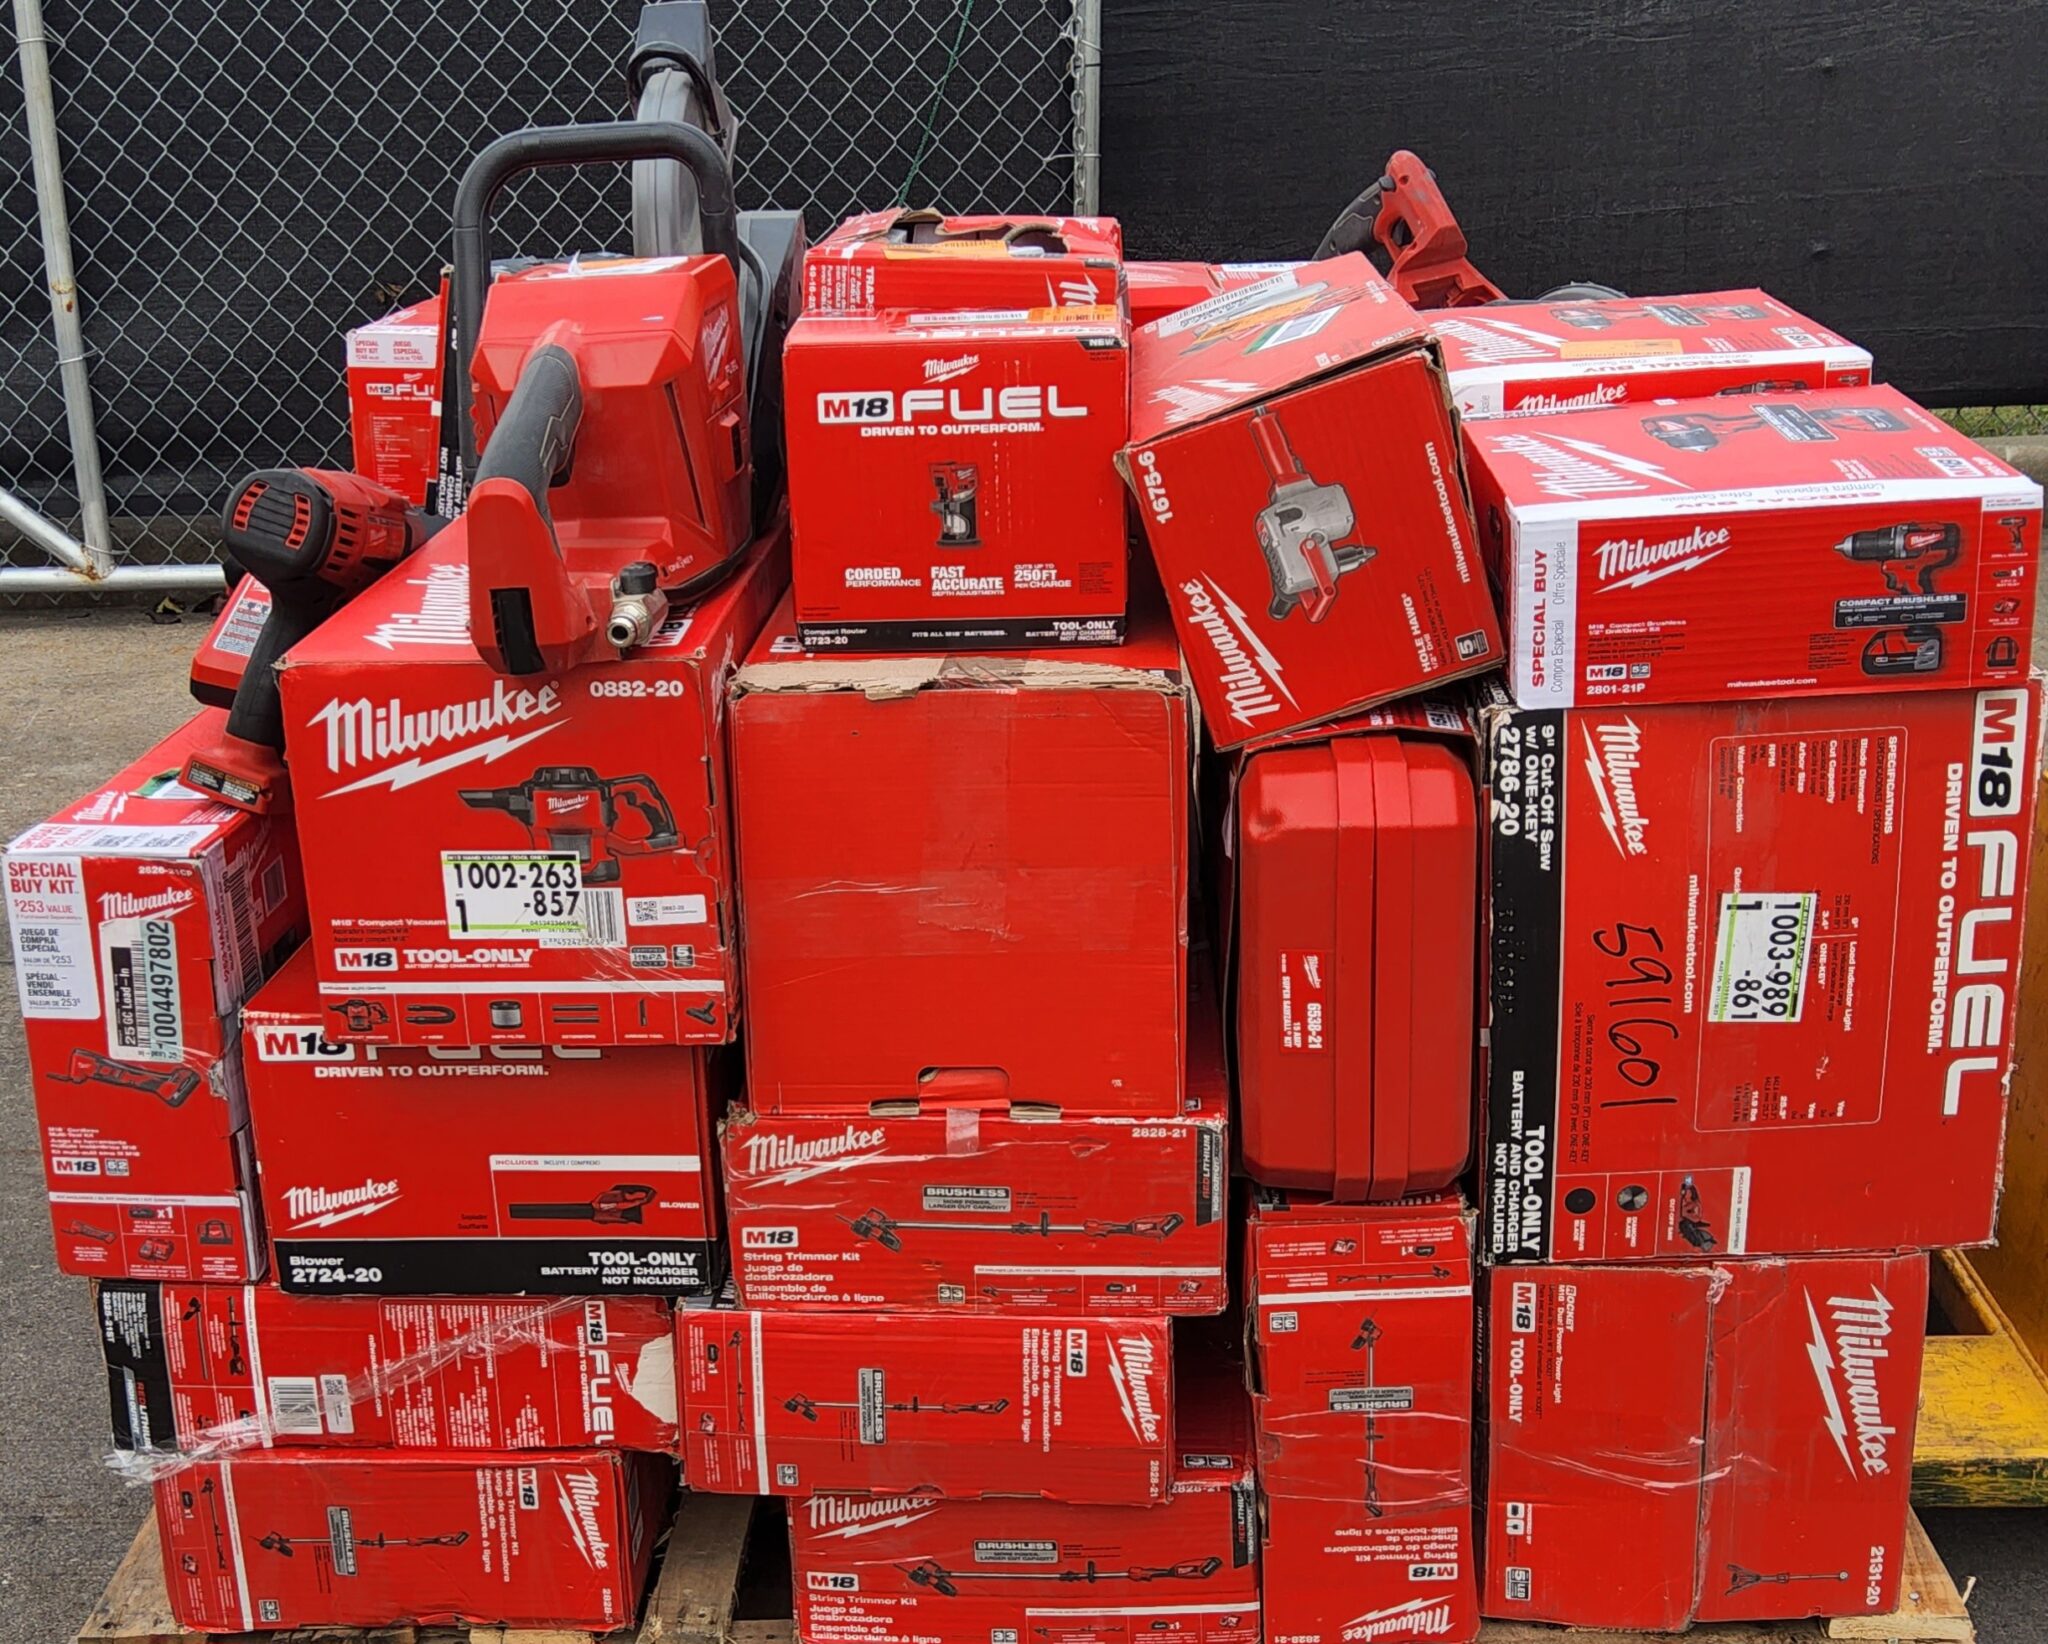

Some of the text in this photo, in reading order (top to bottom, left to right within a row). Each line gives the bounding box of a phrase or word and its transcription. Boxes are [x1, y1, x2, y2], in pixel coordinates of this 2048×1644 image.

[1089, 338, 1116, 347] NEW
[922, 354, 980, 377] Milwaukee
[368, 386, 394, 395] M12
[823, 386, 1088, 422] M18 FUEL
[861, 422, 1045, 437] DRIVEN TO OUTPERFORM.
[1136, 450, 1173, 525] 1675-6
[1424, 441, 1470, 584] milwaukeetool.com
[1592, 526, 1731, 580] Milwaukee
[845, 567, 901, 581] CORDED
[931, 566, 965, 578] FAST
[846, 579, 921, 588] PERFORMANCE
[932, 577, 1004, 590] ACCURATE
[1030, 580, 1072, 588] CHARGE
[1840, 594, 1958, 608] COMPACT BRUSHLESS
[1053, 620, 1115, 630] TOOL-ONLY
[1532, 549, 1548, 688] SPECIAL BUY
[1609, 622, 1646, 630] Compact
[1647, 619, 1687, 627] Brushless
[804, 627, 867, 636] Compact Router
[804, 636, 848, 644] 2723-20
[1402, 597, 1432, 674] HOLE HAWG
[590, 680, 684, 698] 0882-20
[1586, 683, 1646, 695] 2801-21P
[306, 680, 562, 774] Milwaukee
[1767, 744, 1776, 767] RPM
[1826, 739, 1838, 804] Cut Capacity
[1856, 738, 1869, 814] Blade Diameter
[1499, 727, 1521, 836] 2786-20
[1525, 725, 1539, 843] w/ ONE-KEY
[1596, 714, 1649, 856] Milwaukee
[1735, 745, 1746, 832] Water Connection
[1884, 735, 1898, 834] SPECIFICATIONS
[1540, 725, 1555, 871] 9" Cut-Off Saw
[9, 861, 77, 878] SPECIAL
[453, 863, 578, 889] 1002-263
[11, 878, 76, 895] BUY KIT
[14, 900, 73, 915] $253 VALUE
[97, 887, 194, 920] Milwaukee
[524, 890, 580, 917] -857
[1726, 900, 1763, 911] 1
[1926, 762, 1964, 1055] DRIVEN TO OUTPERFORM.
[1943, 697, 2019, 1116] M18 FUEL
[358, 919, 404, 927] Compact
[405, 918, 447, 926] Vacuum
[455, 900, 469, 933] 1
[20, 928, 59, 937] JUEGO DE
[20, 936, 56, 945] COMPRA
[21, 944, 60, 953] ESPECIAL
[1684, 874, 1698, 1014] milwaukeetool.com
[52, 954, 72, 964] $253
[340, 948, 532, 968] M18 TOOL-ONLY
[1762, 901, 1801, 1017] 1003-989
[26, 980, 54, 989] VENDU
[28, 988, 72, 998] ENSEMBLE
[147, 921, 178, 1053] 1004497802
[1282, 976, 1291, 999] SUPER
[1731, 970, 1763, 1020] -861
[124, 1011, 136, 1029] GC
[1307, 1003, 1322, 1048] 6538-21
[125, 1030, 137, 1046] 25
[1283, 1036, 1292, 1048] KIT
[315, 1065, 549, 1078] DRIVEN TO OUTPERFORM.
[1132, 1128, 1187, 1138] 2828-21
[740, 1125, 886, 1176] Milwaukee
[1202, 1134, 1211, 1199] REDLITHIUM
[1506, 1071, 1524, 1253] BATTERY AND CHARGER
[926, 1187, 1007, 1197] BRUSHLESS
[1522, 1125, 1545, 1251] TOOL-ONLY
[280, 1178, 400, 1220] Milwaukee
[659, 1201, 700, 1209] BLOWER
[1493, 1143, 1507, 1254] NOT INCLUDED
[746, 1231, 794, 1244] M18
[289, 1255, 344, 1266] Blower
[589, 1252, 696, 1266] TOOL-ONLY
[743, 1252, 860, 1262] String Trimmer Kit
[292, 1267, 382, 1283] 2724-20
[541, 1266, 698, 1276] BATTERY AND CHARGER
[1070, 1332, 1084, 1374] M18
[1509, 1286, 1532, 1423] M18 TOOL-ONLY
[1053, 1329, 1062, 1426] String Trimmer Kit
[1827, 1283, 1897, 1477] Milwaukee
[1117, 1331, 1161, 1444] Milwaukee
[873, 1371, 884, 1441] BRUSHLESS
[1333, 1400, 1410, 1411] BRUSHLESS
[1150, 1459, 1160, 1498] 2828-21
[978, 1541, 1054, 1551] BRUSHLESS
[1526, 1535, 1532, 1545] BY
[1412, 1566, 1455, 1578] M18
[1865, 1545, 1885, 1606] 2131-20
[811, 1575, 856, 1589] M18
[1513, 1569, 1527, 1597] 5 LED
[809, 1594, 917, 1606] String Trimmer Kit
[1341, 1604, 1456, 1642] Milwaukee
[1274, 1635, 1321, 1643] 2828-21
